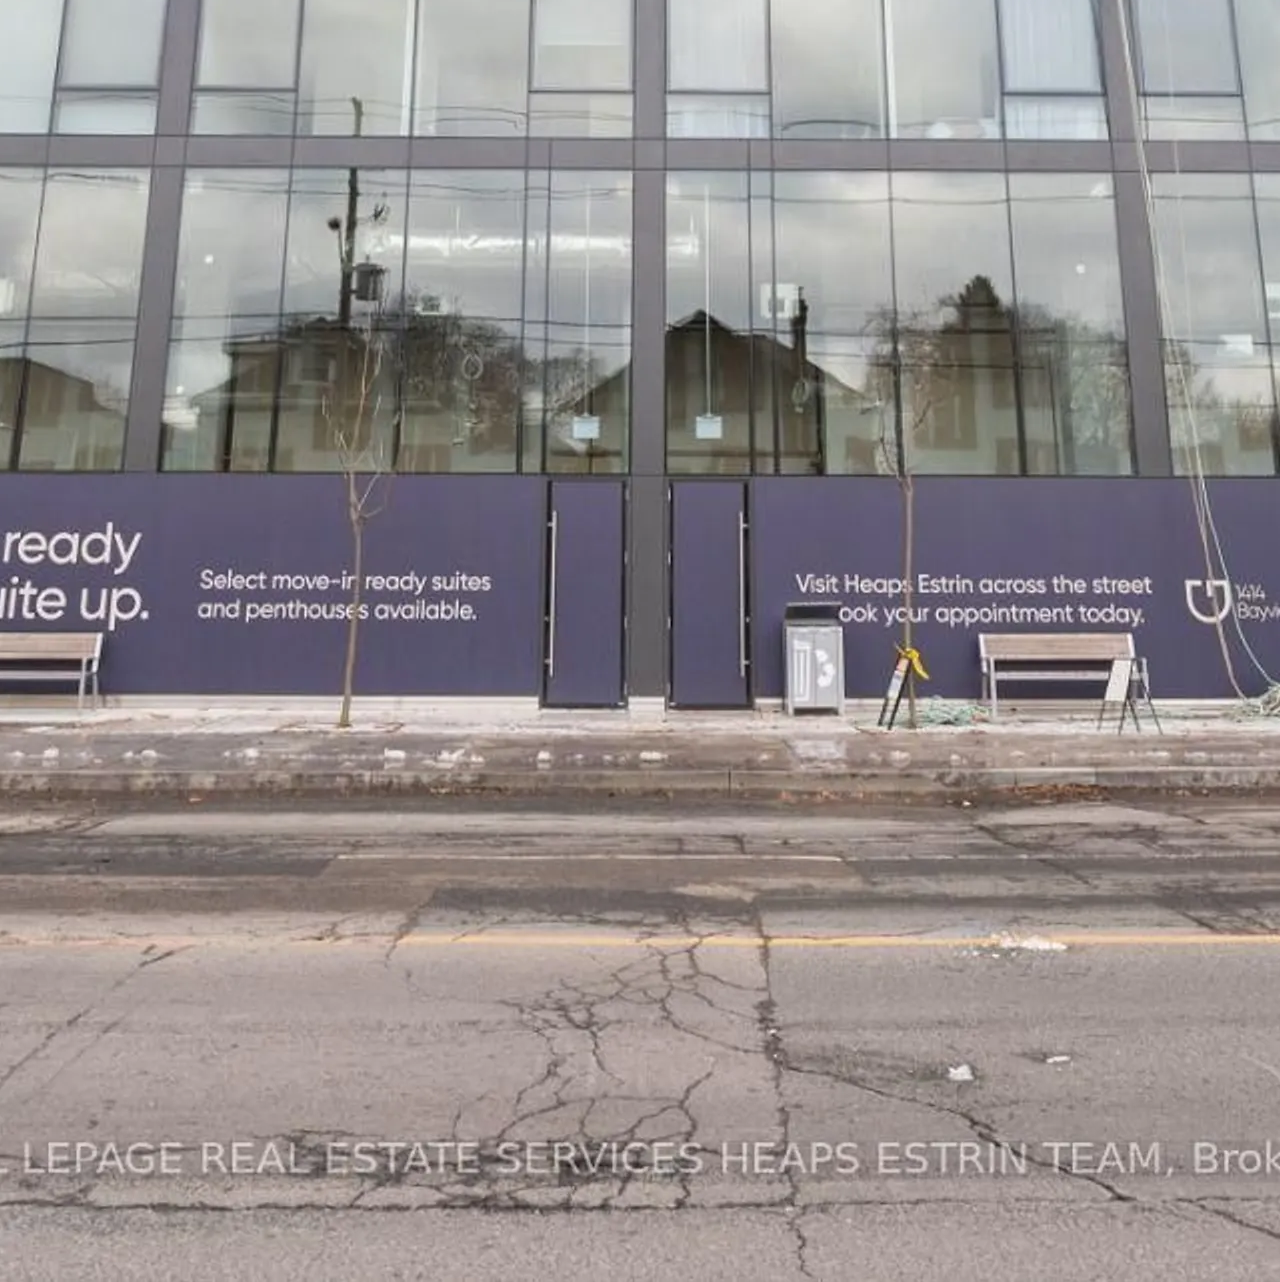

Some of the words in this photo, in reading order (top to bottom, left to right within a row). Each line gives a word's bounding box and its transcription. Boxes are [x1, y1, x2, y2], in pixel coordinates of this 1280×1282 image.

[3, 521, 142, 575] ready
[200, 568, 267, 590] Select
[365, 570, 427, 596] ready
[431, 570, 493, 591] suites
[795, 574, 839, 594] Visit
[844, 574, 914, 598] Heaps
[918, 574, 974, 594] Estrin
[978, 577, 1047, 594] across
[1052, 574, 1087, 594] the
[1091, 576, 1153, 595] street
[1234, 583, 1266, 600] 1414
[80, 587, 149, 631] up.
[198, 599, 240, 618] and
[245, 599, 369, 623] penthouses
[373, 599, 477, 620] available.
[837, 603, 879, 623] ook
[883, 606, 930, 627] your
[934, 603, 1073, 628] appointment
[1078, 603, 1146, 627] today.
